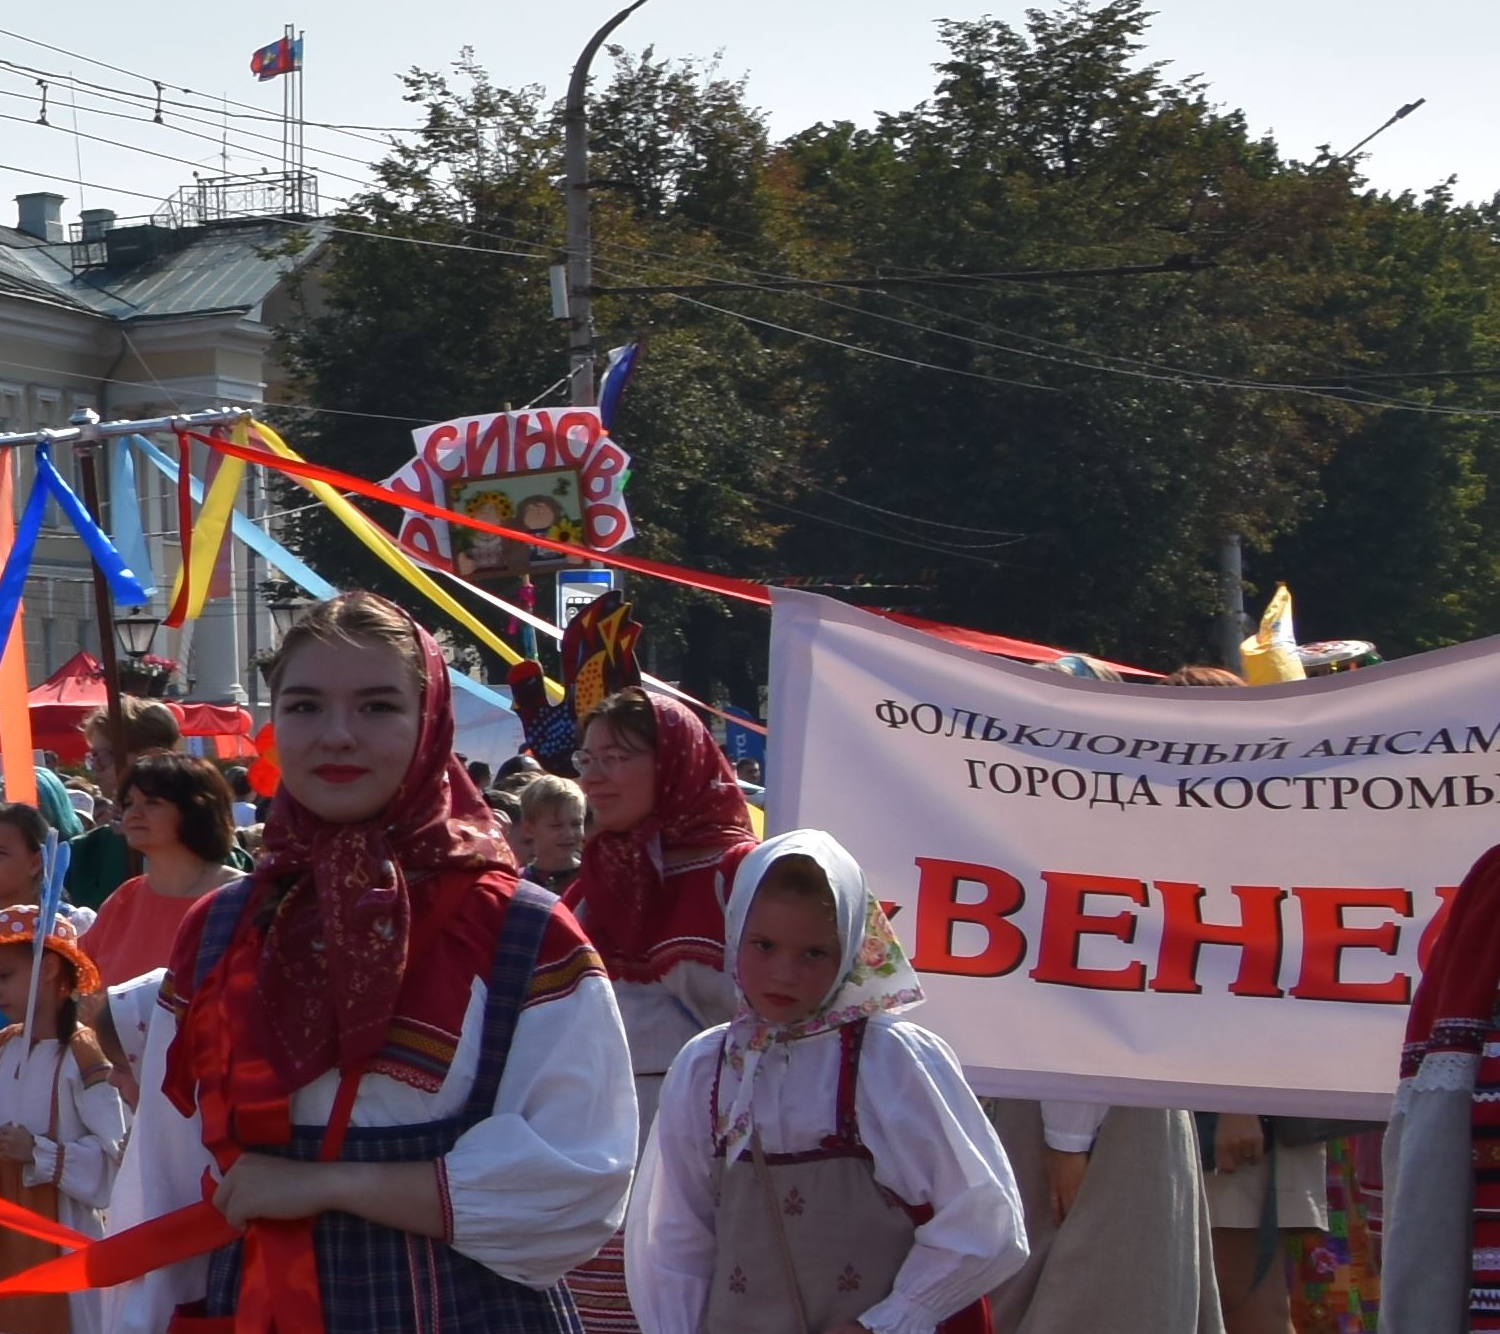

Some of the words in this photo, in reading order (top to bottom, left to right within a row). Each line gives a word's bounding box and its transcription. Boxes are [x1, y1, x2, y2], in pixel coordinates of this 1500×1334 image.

[391, 410, 627, 561] РУСИНОВО
[874, 698, 1293, 766] ФОЛЬКЛОРНЫЙ
[963, 758, 1163, 812] ГОРОДА
